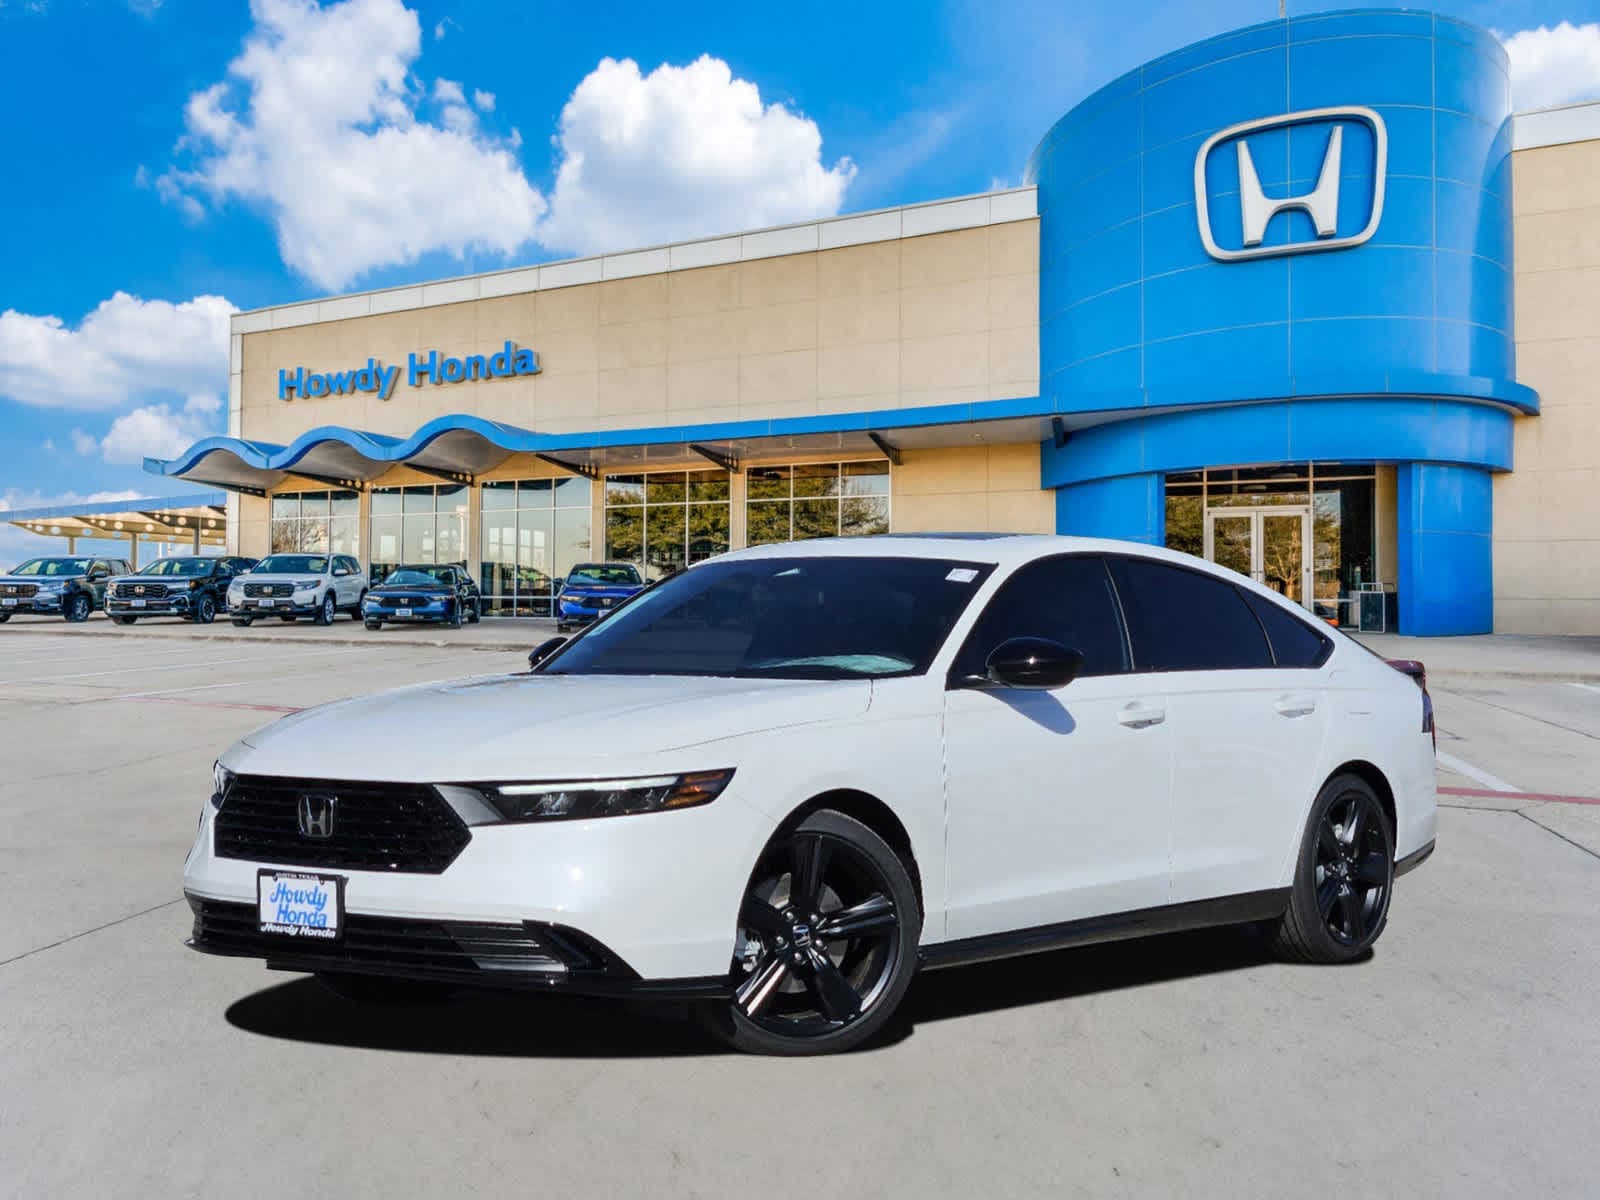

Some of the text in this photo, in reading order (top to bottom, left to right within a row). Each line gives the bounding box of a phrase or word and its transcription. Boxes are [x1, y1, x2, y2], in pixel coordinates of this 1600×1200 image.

[279, 340, 541, 401] Howdy Honda
[270, 882, 328, 911] Howdy
[276, 903, 327, 928] Honda
[260, 922, 336, 938] Howdy Honda
